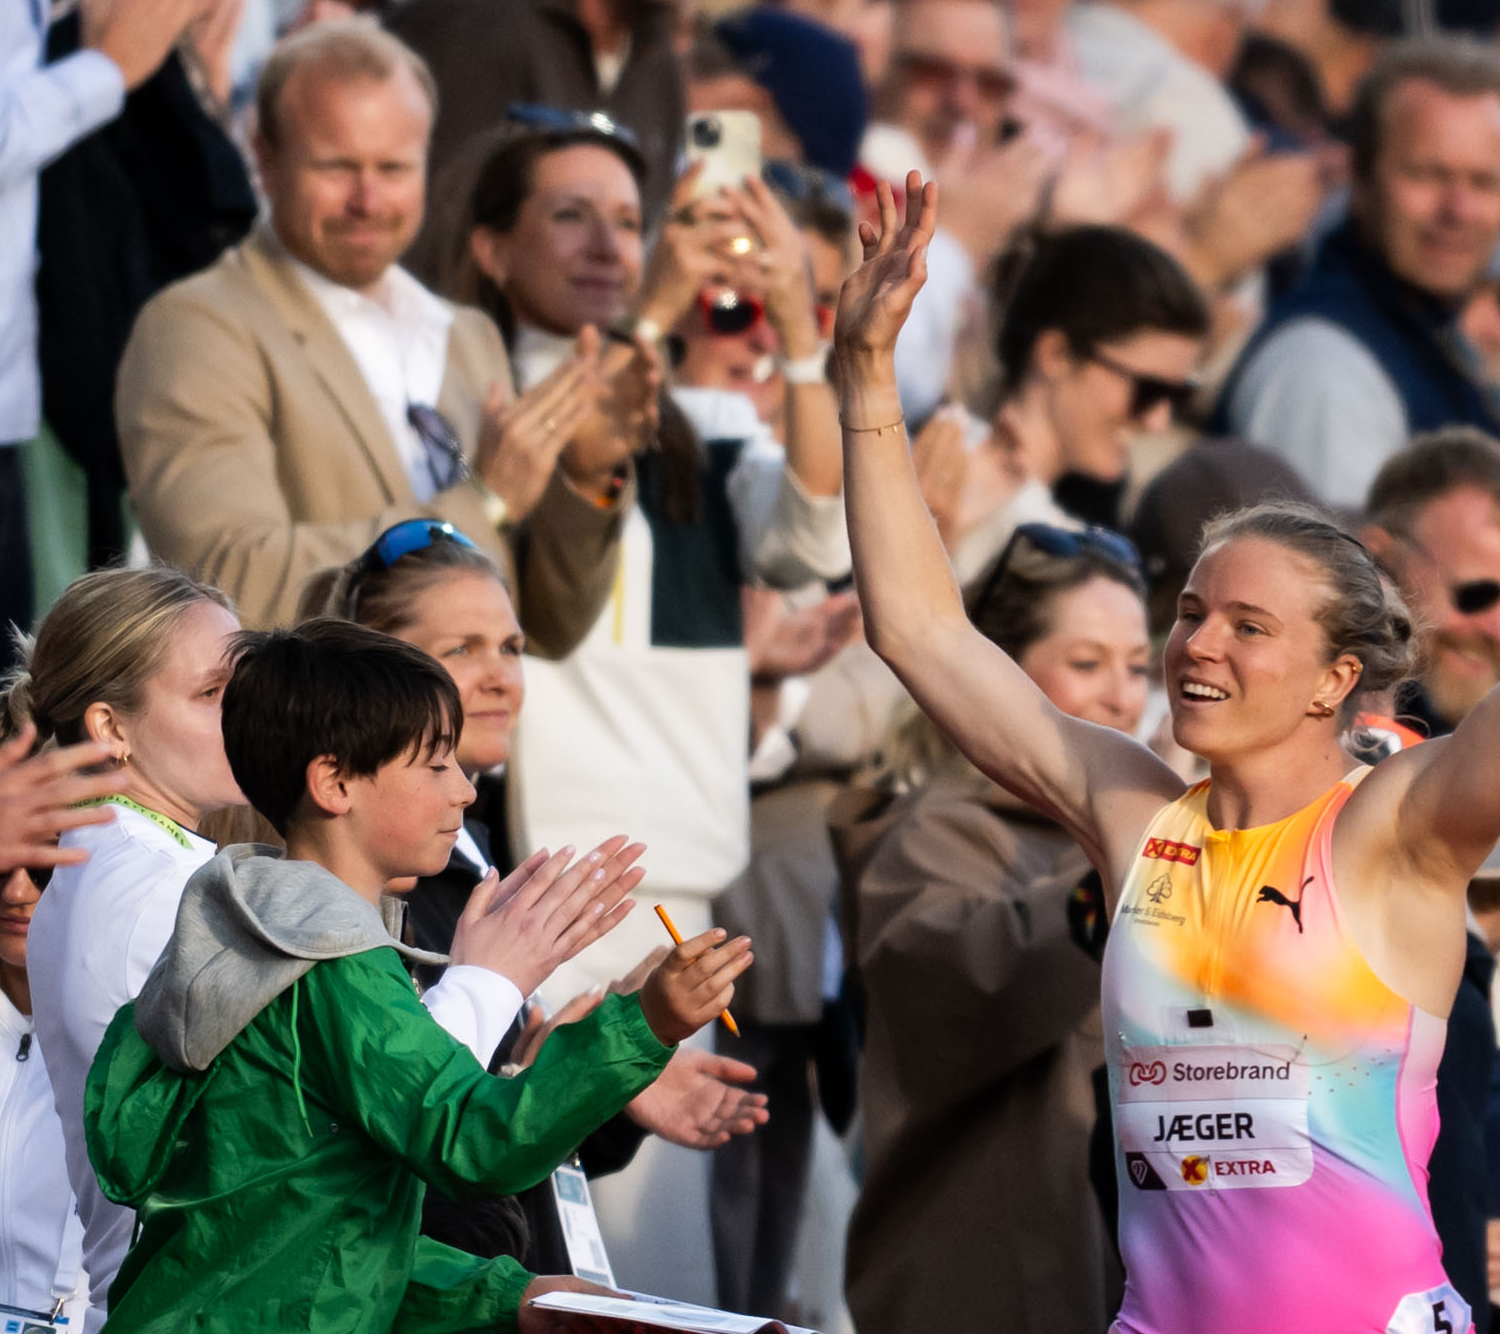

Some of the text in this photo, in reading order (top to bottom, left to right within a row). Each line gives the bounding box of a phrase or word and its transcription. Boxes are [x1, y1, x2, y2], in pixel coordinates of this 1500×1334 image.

[1173, 1060, 1291, 1082] Storebrand
[1153, 1112, 1256, 1142] JÆGER
[1214, 1159, 1277, 1176] EXTRA
